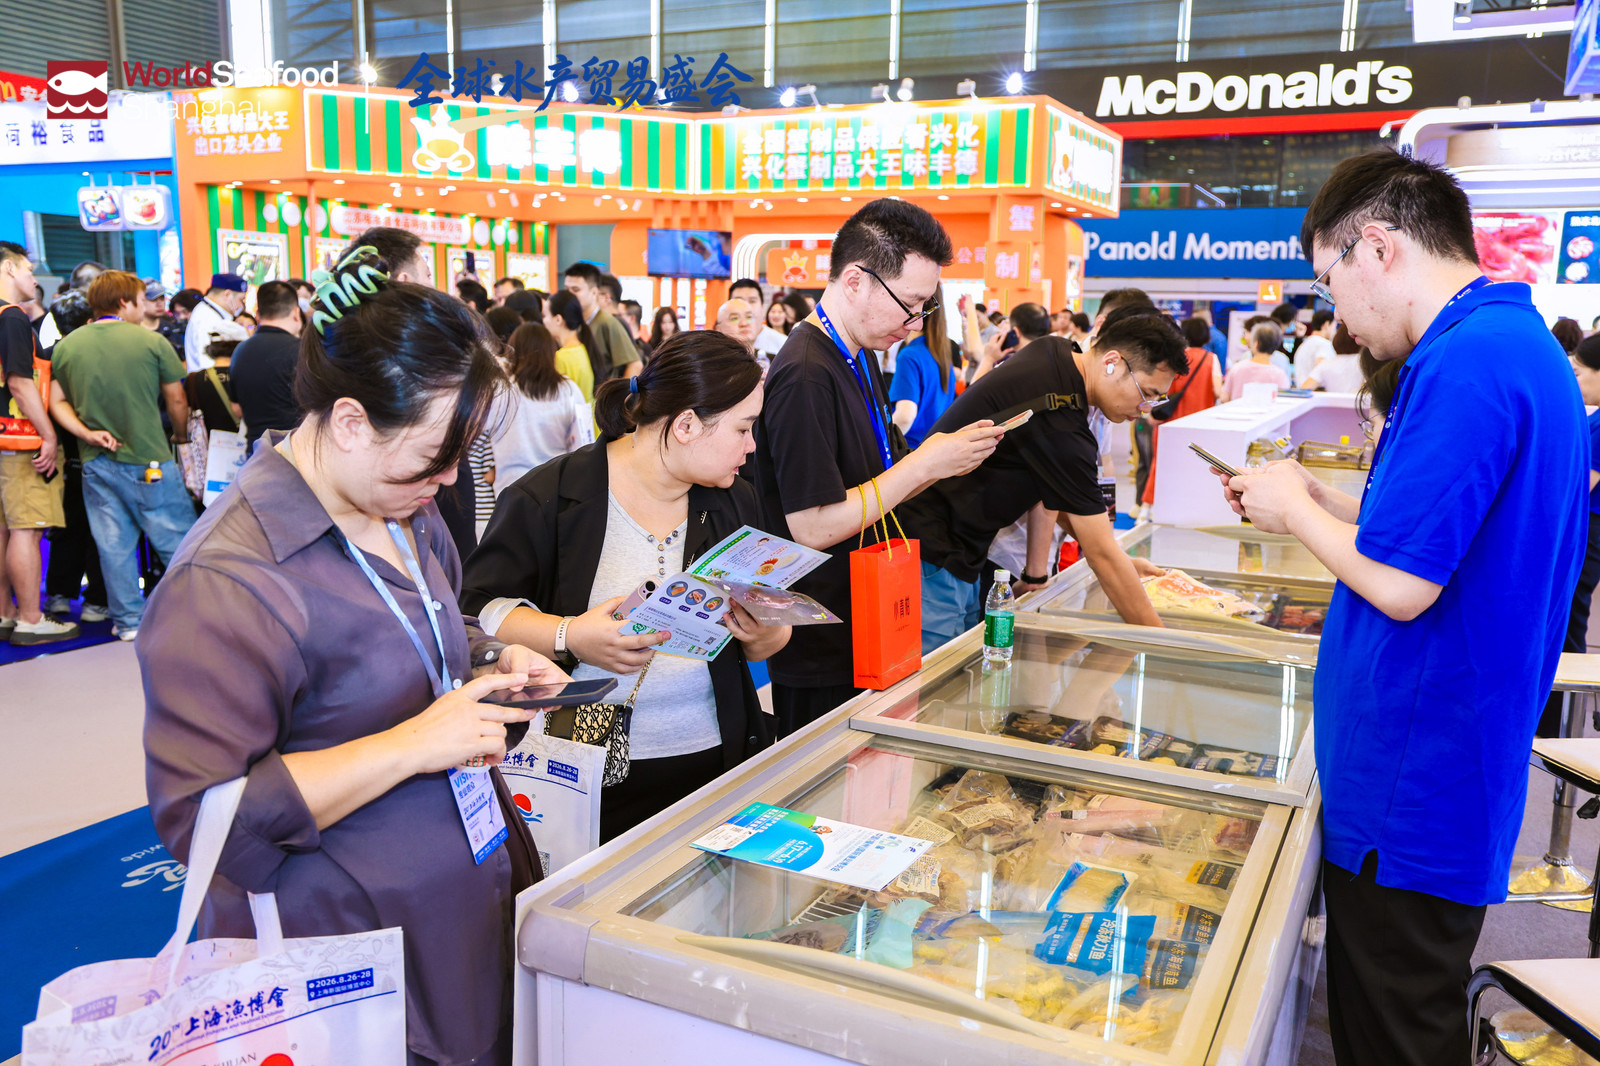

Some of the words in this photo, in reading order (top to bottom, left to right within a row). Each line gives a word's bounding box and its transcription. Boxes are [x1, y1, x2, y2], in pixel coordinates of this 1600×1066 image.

[1096, 60, 1413, 117] McDonald's
[194, 132, 283, 156] 出口龙头企业
[1084, 231, 1177, 261] Panold
[315, 970, 371, 989] 2026.8.26-28
